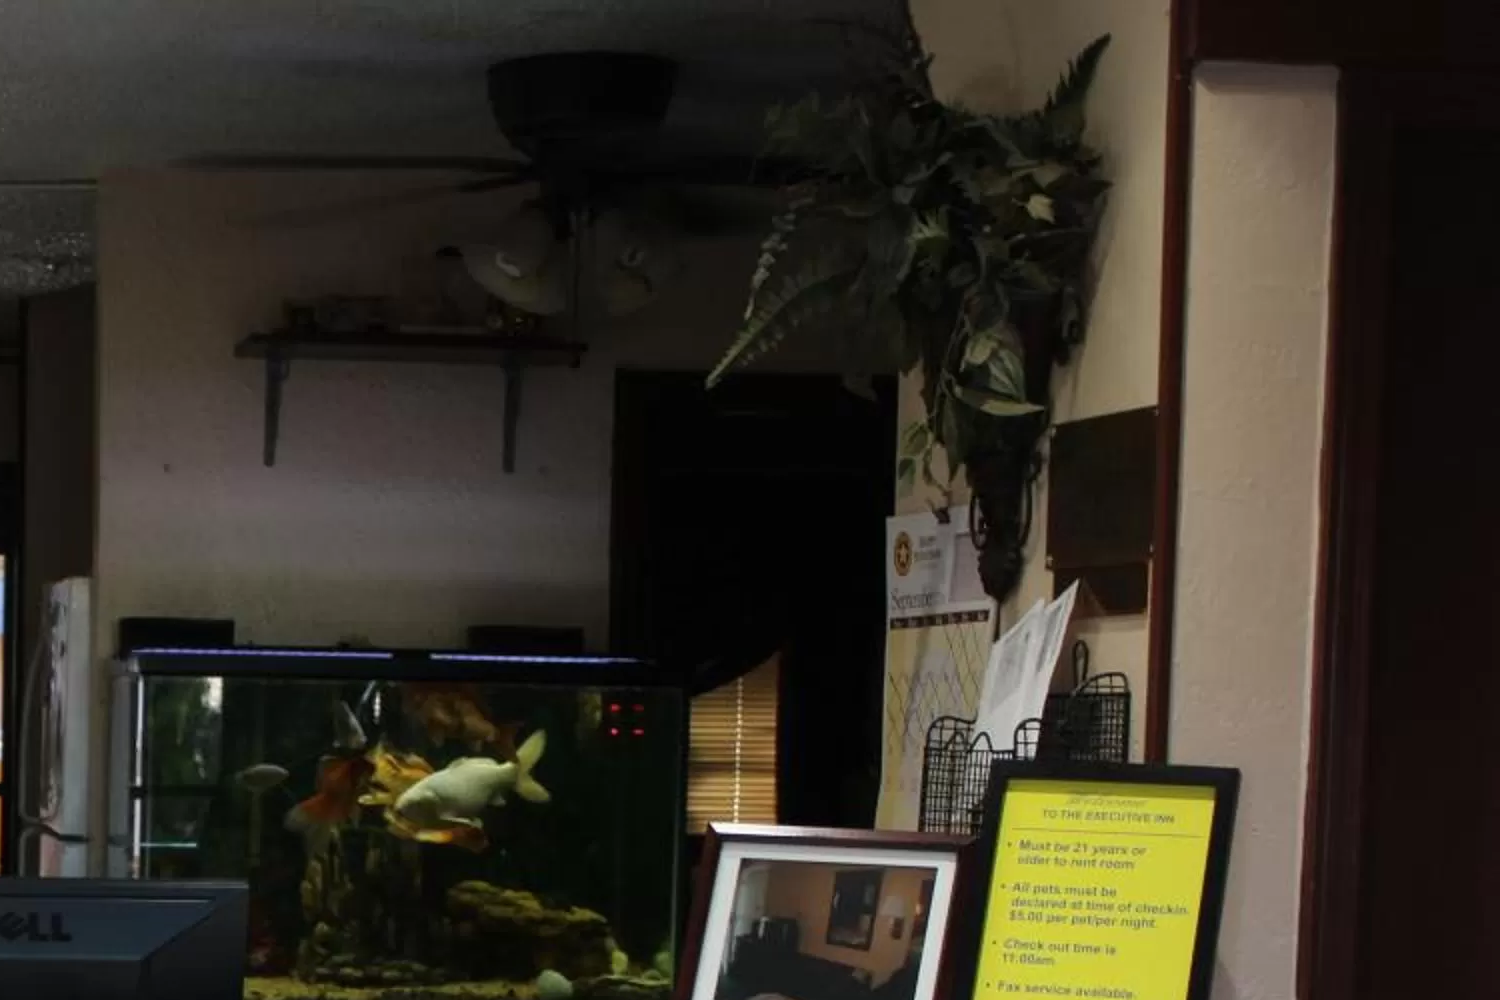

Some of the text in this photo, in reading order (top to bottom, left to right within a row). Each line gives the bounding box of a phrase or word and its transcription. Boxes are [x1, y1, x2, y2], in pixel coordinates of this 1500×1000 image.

[1043, 809, 1176, 824] TO THE EXECUTIVE INN
[1019, 839, 1146, 856] Must be 21 years or
[1018, 854, 1135, 869] older to rent room
[1012, 883, 1117, 897] All pets must be
[1011, 897, 1067, 910] declared
[1071, 900, 1083, 910] at
[1086, 900, 1114, 912] time
[1117, 902, 1132, 913] of
[1009, 910, 1043, 923] $5.00
[1046, 913, 1069, 926] per
[1071, 914, 1118, 928] pet/per
[1004, 938, 1116, 955] Check out time is
[997, 980, 1020, 992] Fax
[1025, 983, 1071, 995] service
